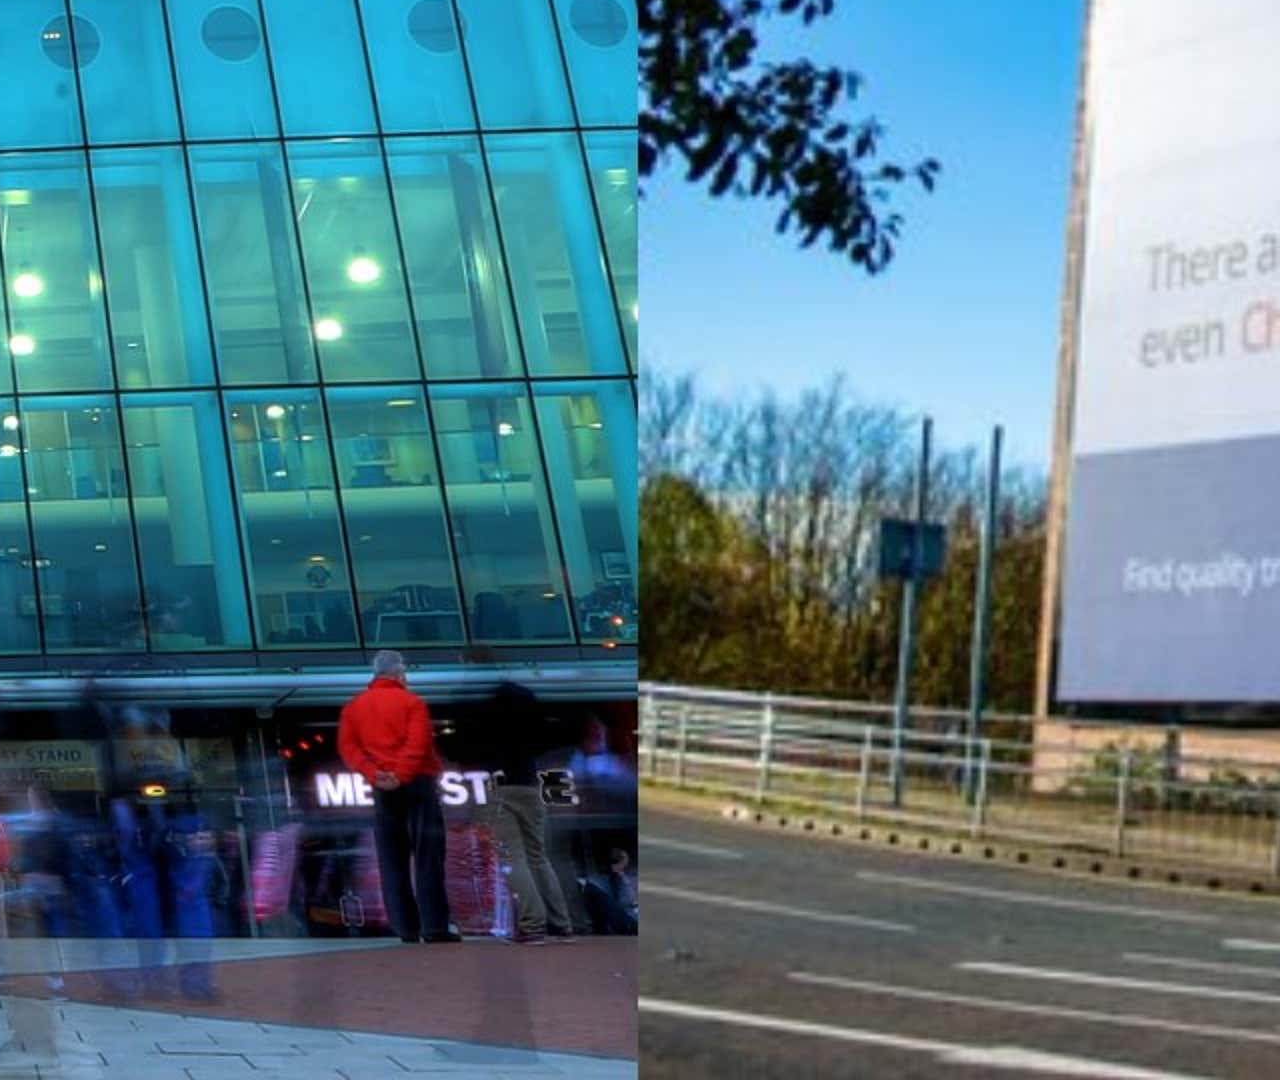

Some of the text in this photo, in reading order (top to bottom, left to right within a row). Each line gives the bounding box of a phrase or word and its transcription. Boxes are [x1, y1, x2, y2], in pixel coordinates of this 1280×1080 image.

[1144, 237, 1249, 293] There
[1139, 320, 1224, 369] even
[1123, 556, 1171, 593] Find
[1174, 550, 1253, 597] quality
